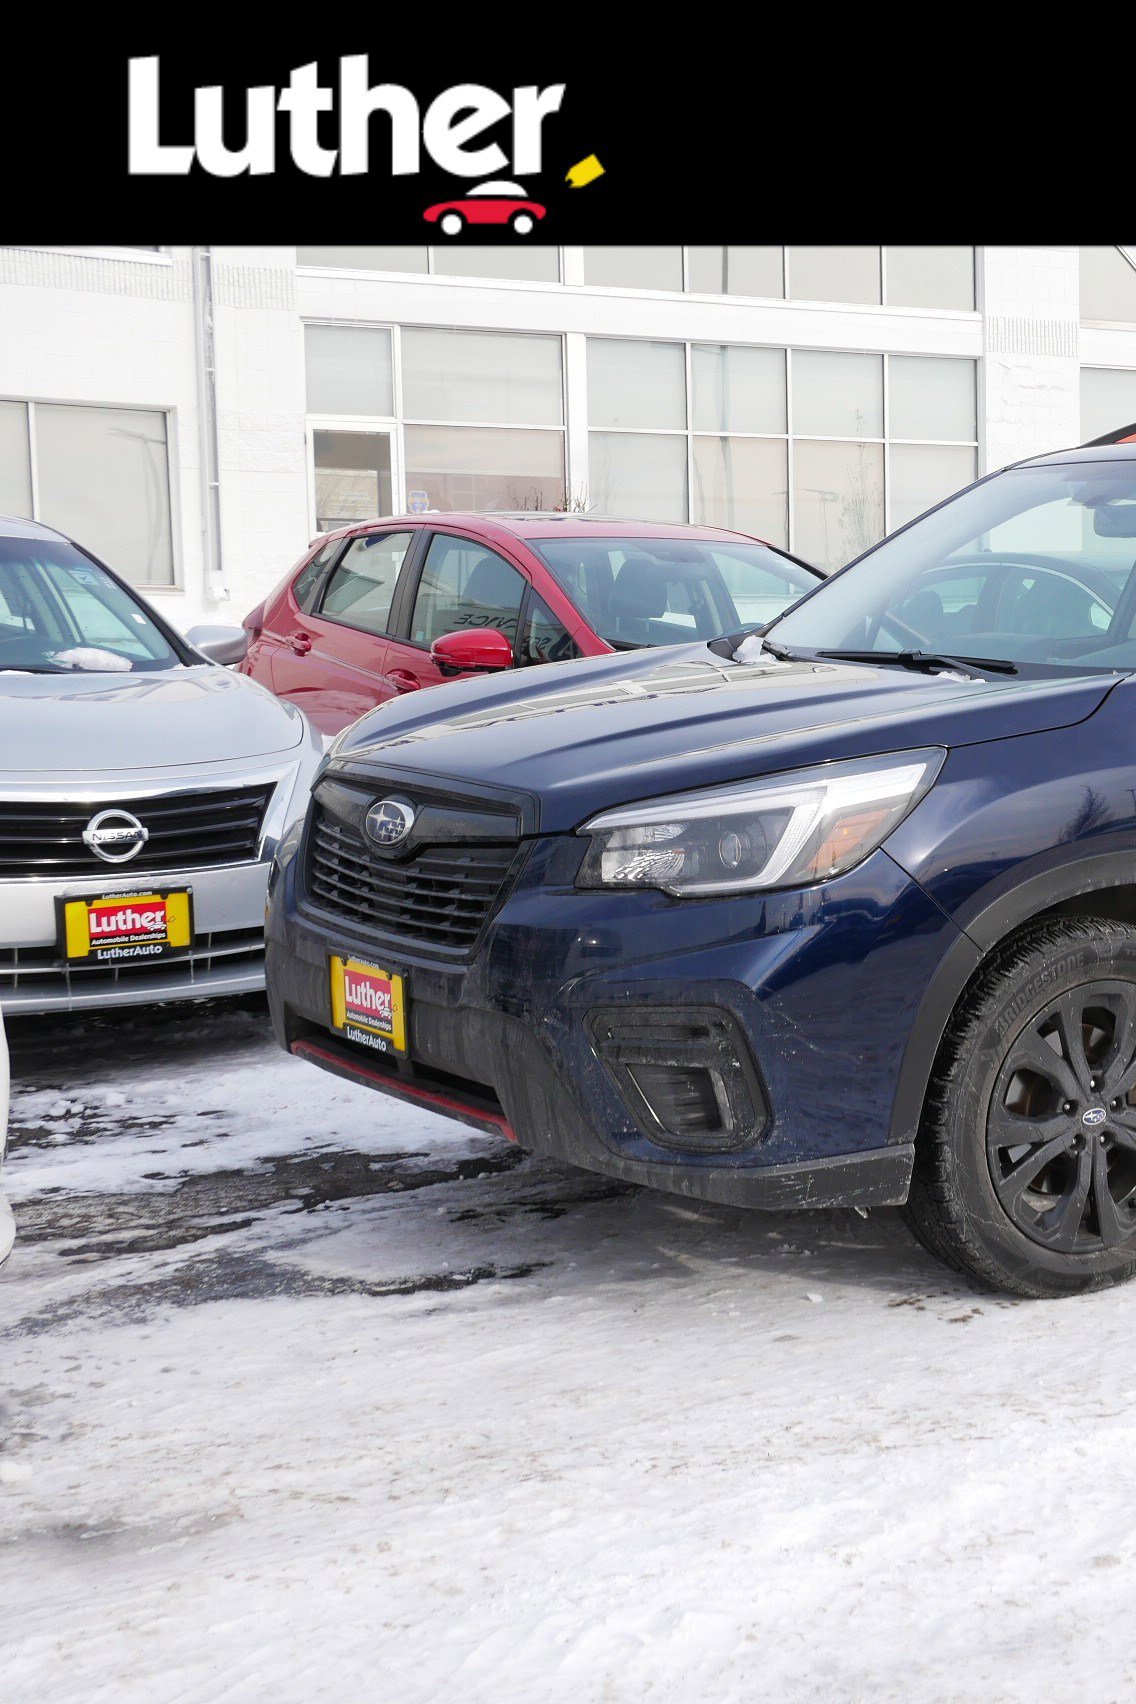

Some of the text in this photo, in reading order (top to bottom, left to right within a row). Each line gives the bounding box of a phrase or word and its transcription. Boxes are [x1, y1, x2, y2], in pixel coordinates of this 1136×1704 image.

[92, 831, 144, 841] NISSAN
[89, 909, 165, 933] Luther
[91, 932, 166, 946] Automobile Dealerships
[97, 944, 163, 960] LutherAuto
[345, 976, 391, 1012] Luther
[347, 1026, 387, 1051] LutherAuto
